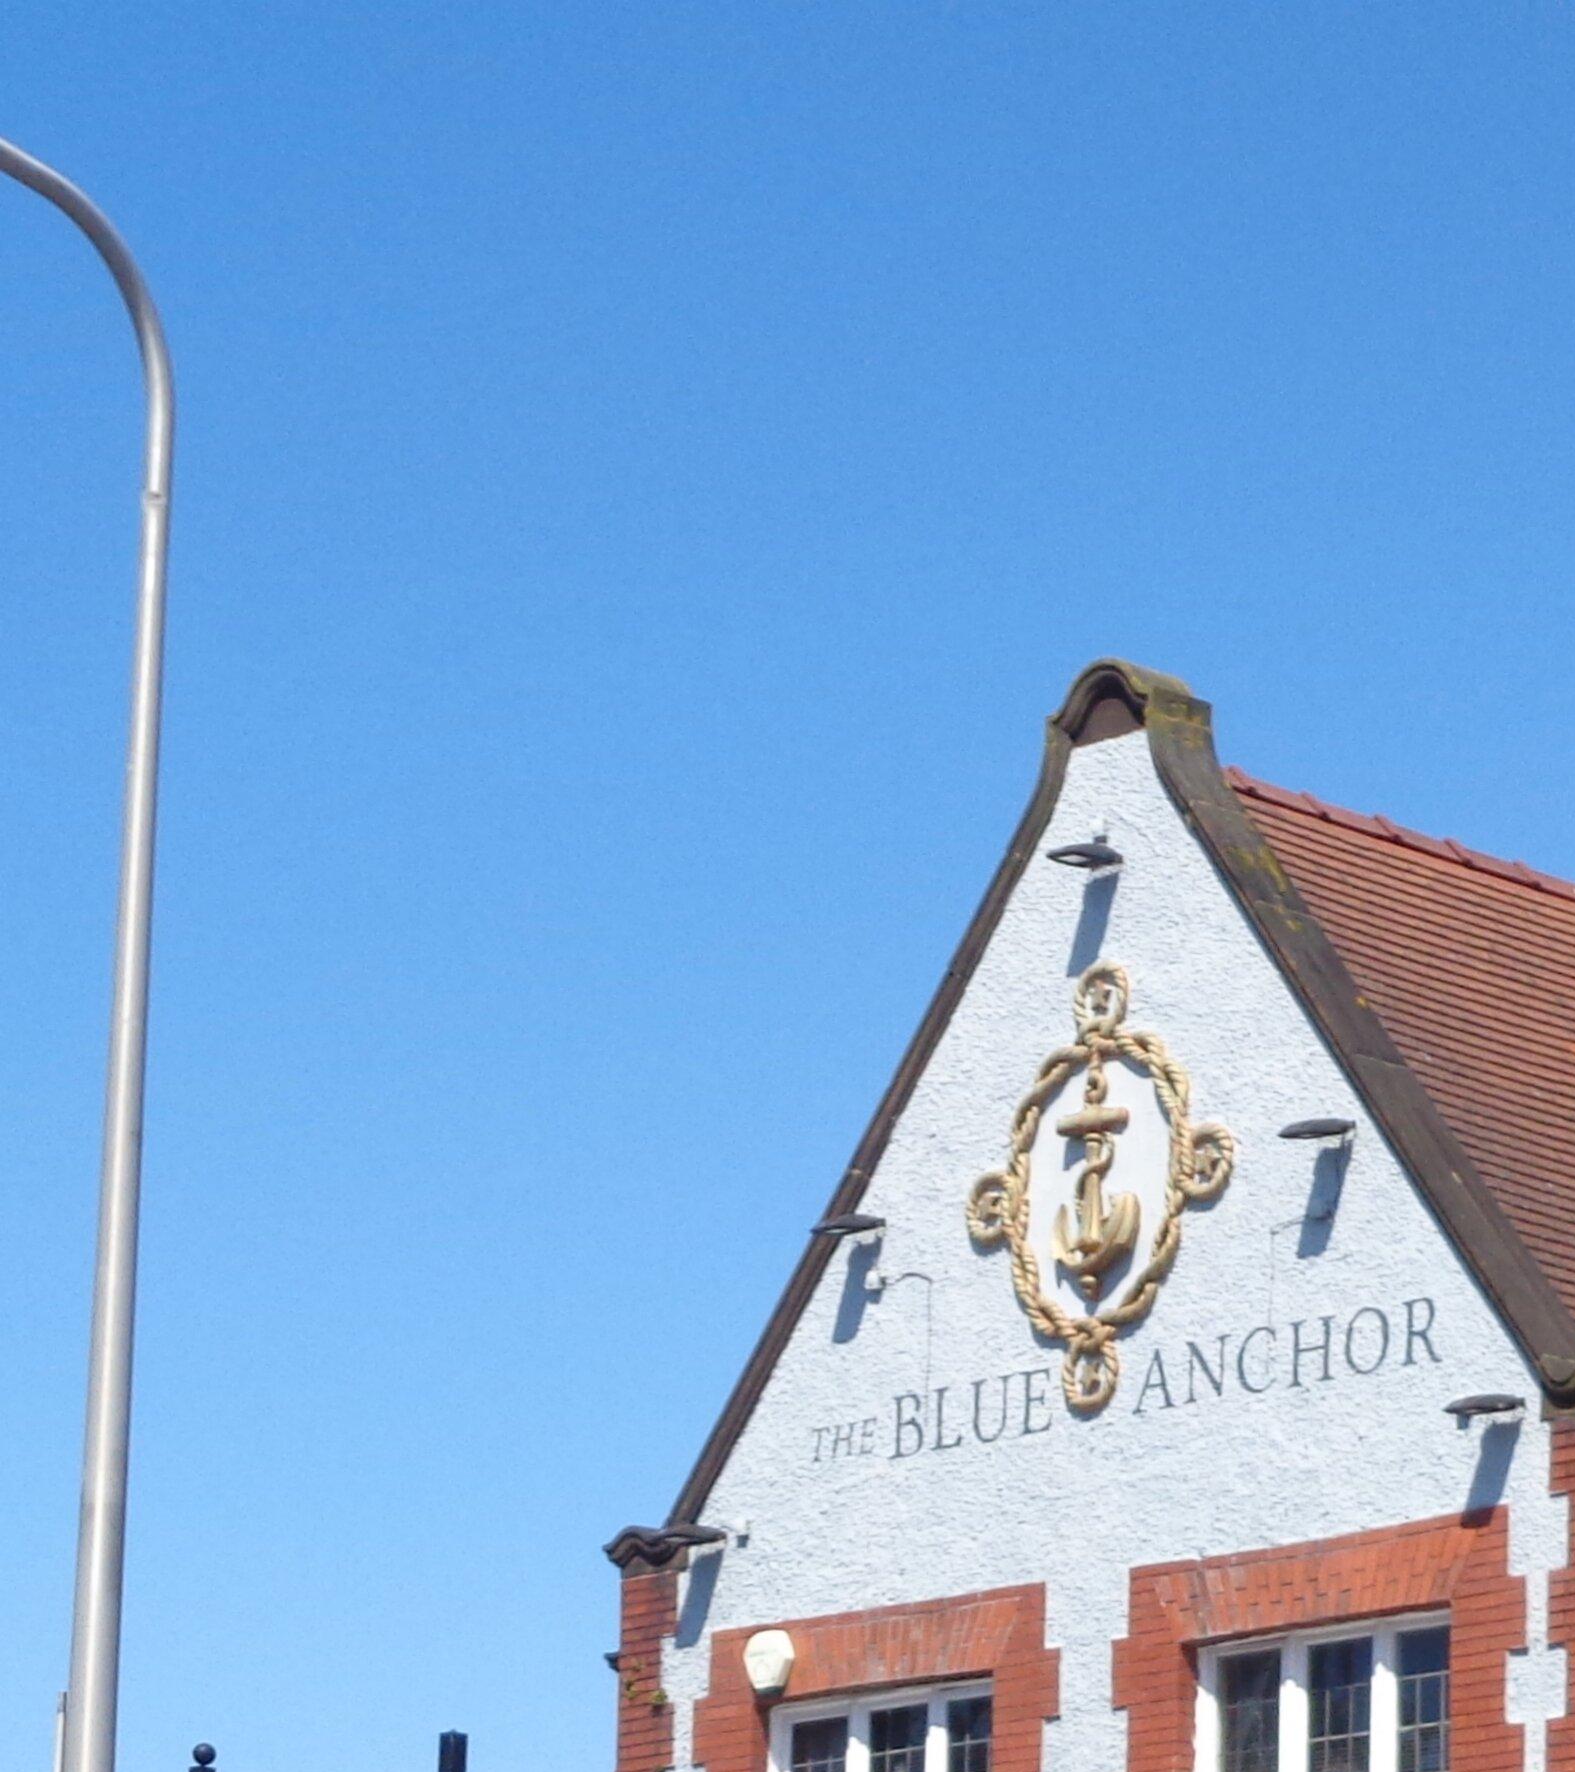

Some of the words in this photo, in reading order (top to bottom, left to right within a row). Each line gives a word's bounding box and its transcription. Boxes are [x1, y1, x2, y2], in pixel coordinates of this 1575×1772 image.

[811, 1416, 878, 1464] THE
[888, 1368, 1053, 1461] BLUE
[1132, 1296, 1444, 1415] ANCHOR
